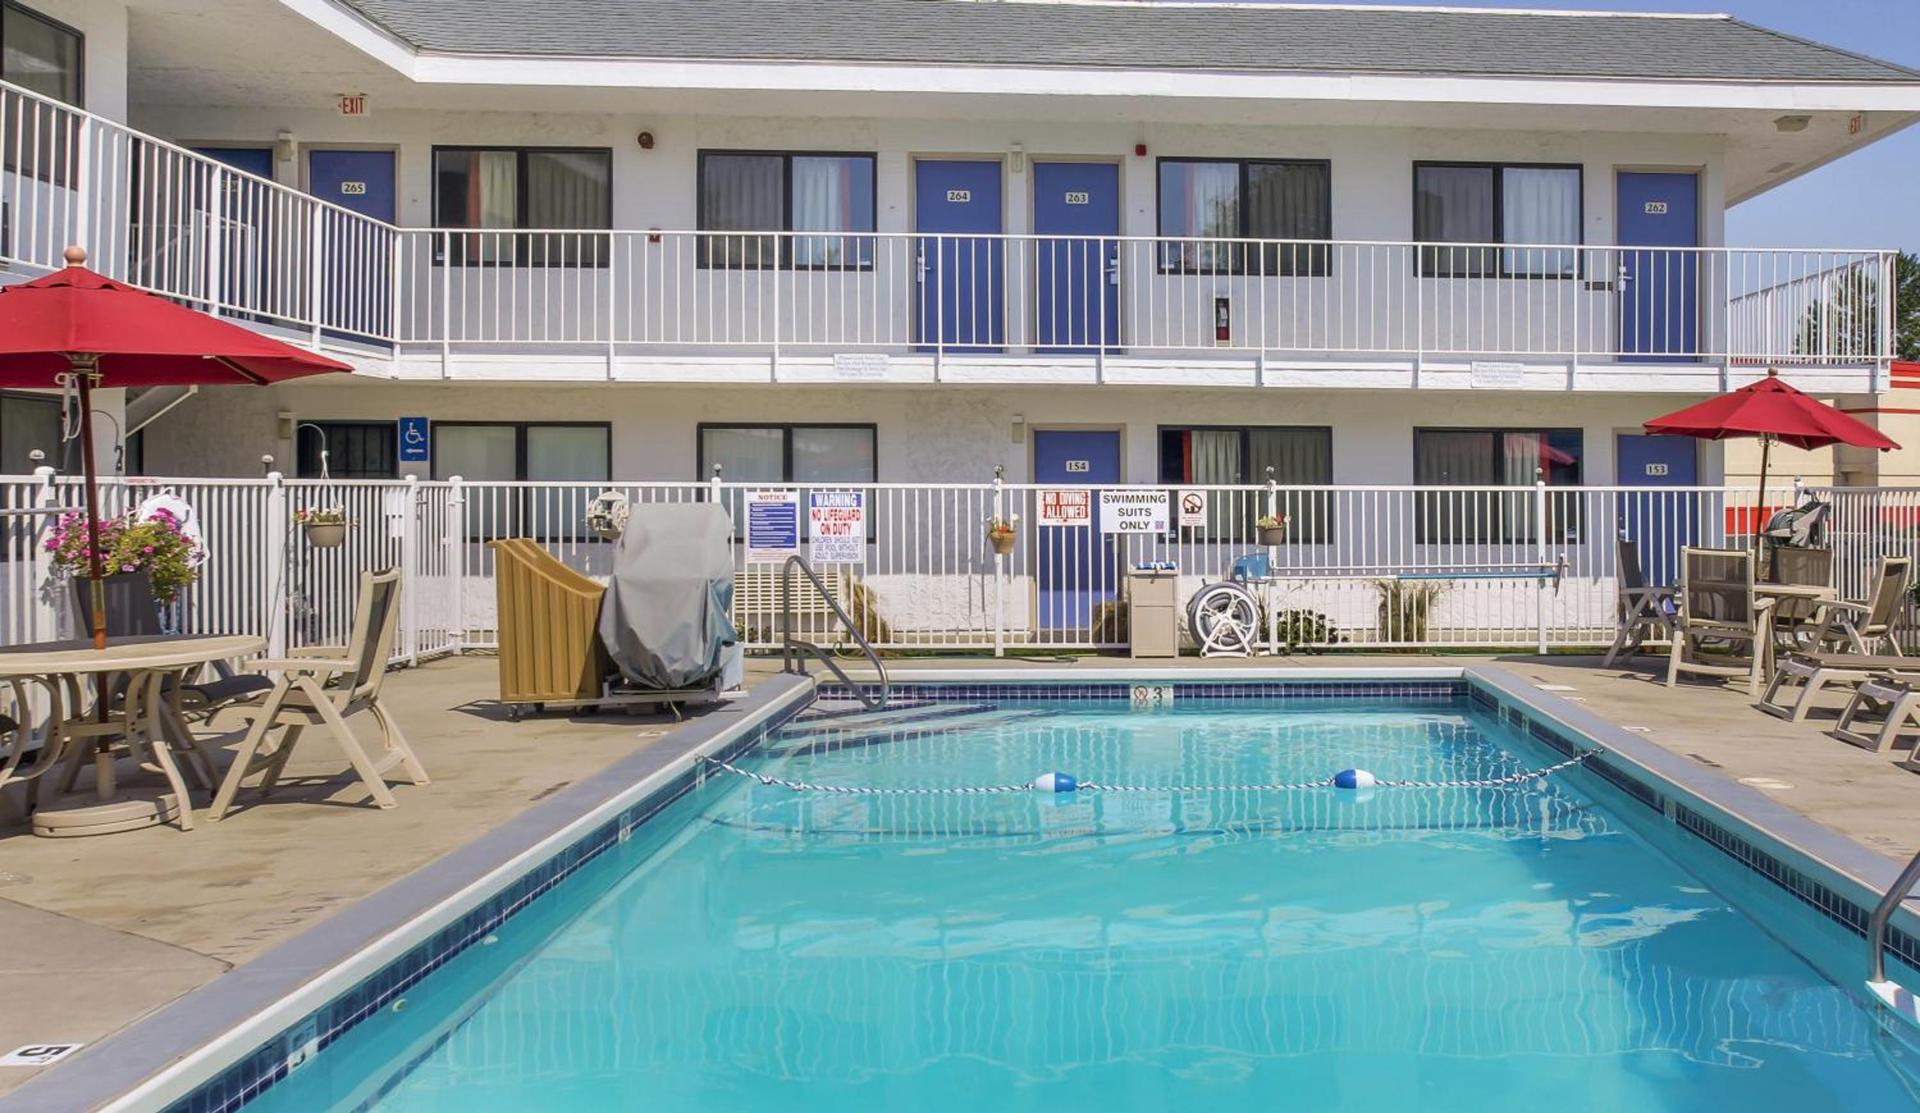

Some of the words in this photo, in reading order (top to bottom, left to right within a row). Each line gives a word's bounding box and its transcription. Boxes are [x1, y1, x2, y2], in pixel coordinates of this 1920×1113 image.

[342, 97, 364, 114] EXIT
[343, 183, 364, 193] 265
[949, 191, 968, 201] 264
[1067, 193, 1086, 203] 263
[1647, 203, 1665, 213] 262
[1068, 461, 1086, 471] 154
[1648, 465, 1665, 474] 153
[814, 493, 858, 507] WARNING
[1045, 493, 1056, 506] NO
[1059, 493, 1087, 506] DIVING
[1103, 494, 1167, 504] SWIMMING
[811, 509, 821, 521] NO
[823, 509, 861, 521] LIFEGUARD
[1046, 505, 1087, 518] ALLOWED
[1118, 507, 1152, 517] SUITS
[820, 522, 831, 535] ON
[833, 522, 852, 535] DUTY
[1119, 520, 1150, 530] ONLY
